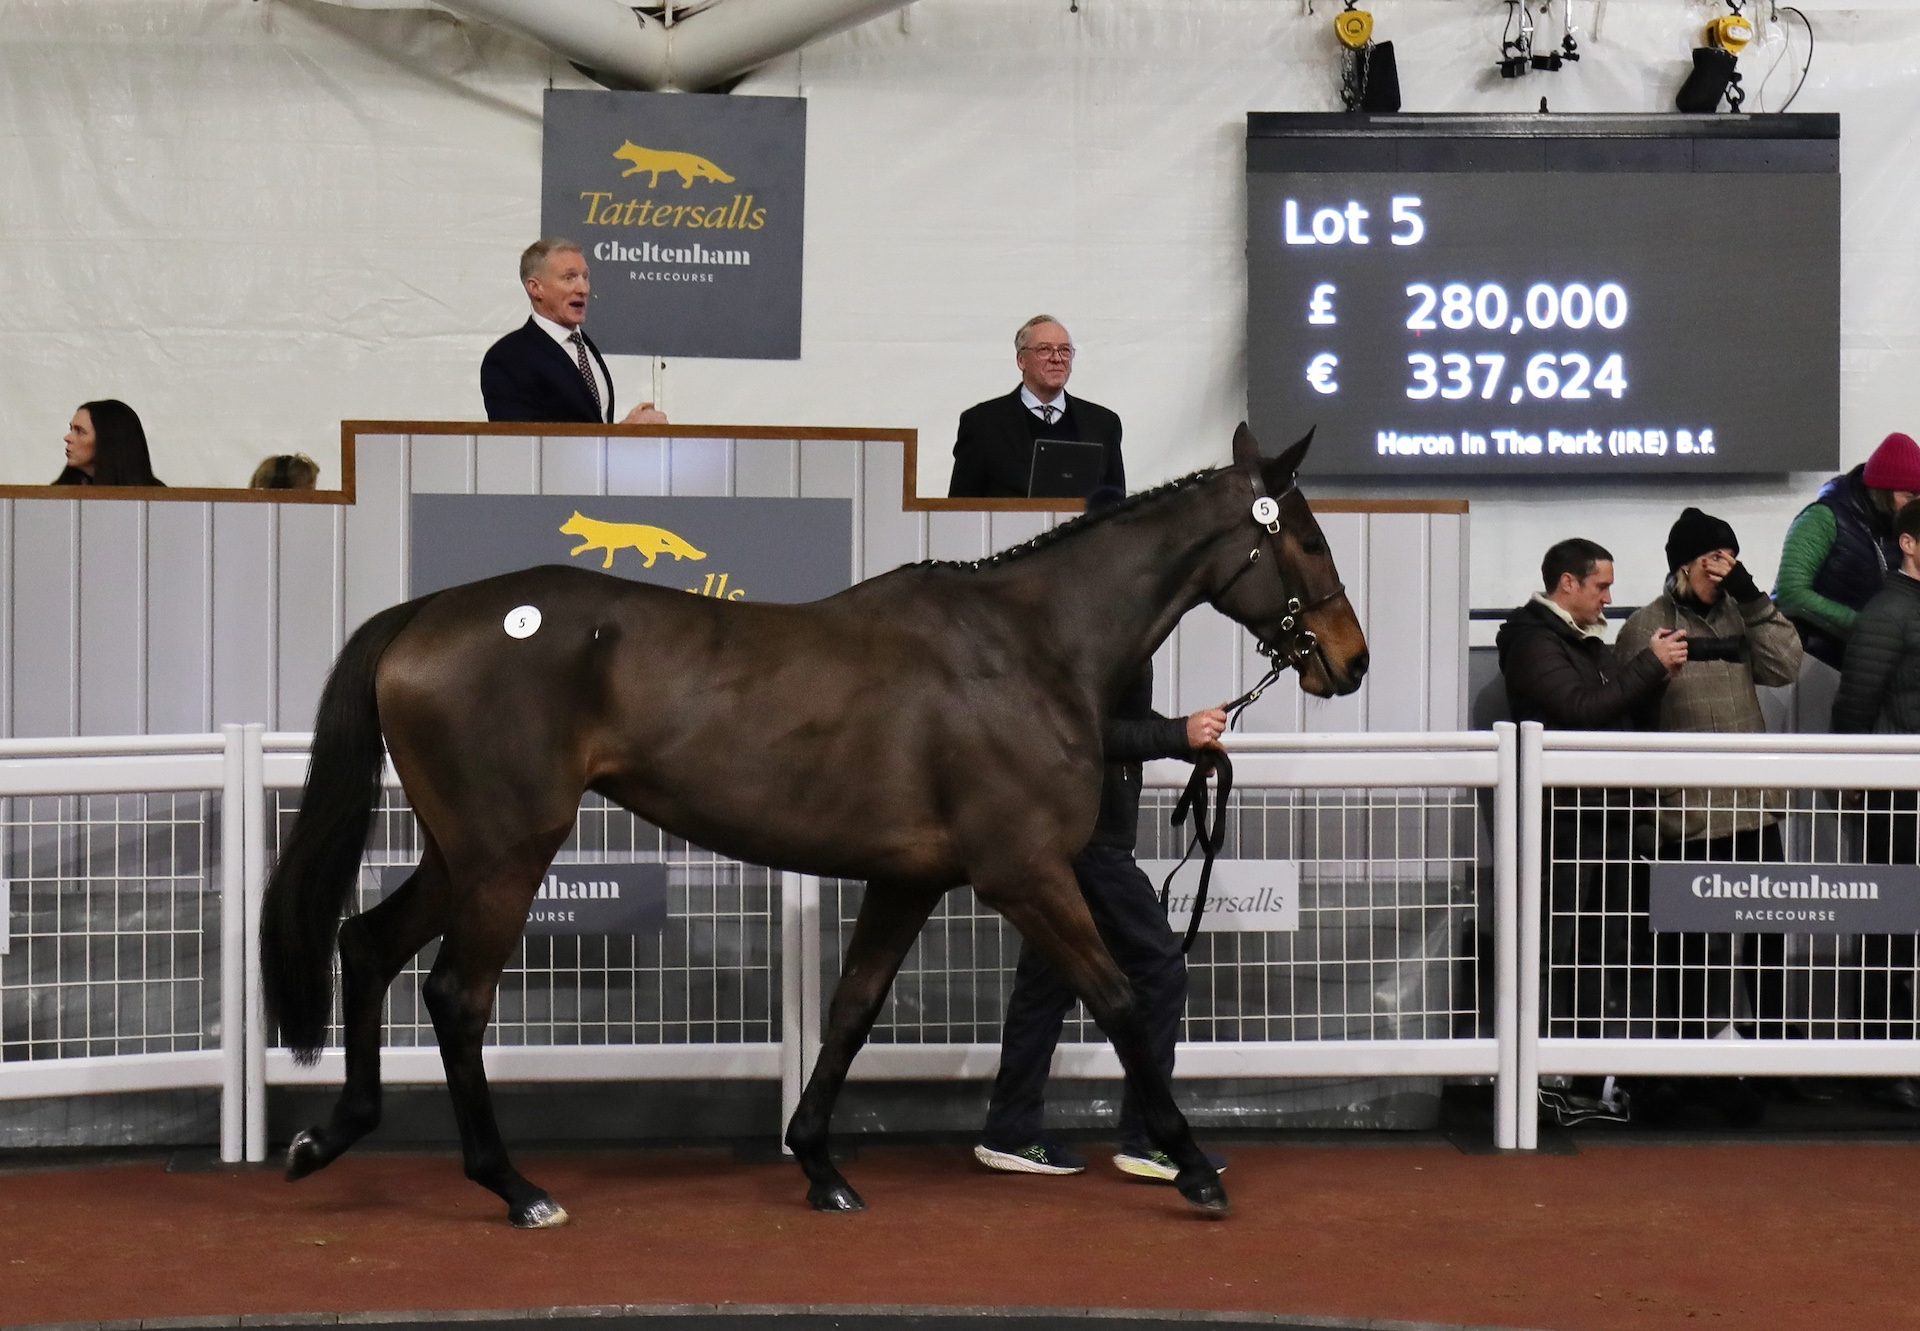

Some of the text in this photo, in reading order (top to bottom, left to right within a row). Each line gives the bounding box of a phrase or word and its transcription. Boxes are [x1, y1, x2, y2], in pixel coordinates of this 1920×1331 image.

[580, 191, 768, 230] Tattersalls
[1284, 196, 1426, 246] Lot 5
[593, 240, 751, 266] Cheltenham
[629, 271, 714, 283] RACECOURSE
[1308, 282, 1629, 335] £ 280,000
[1306, 352, 1628, 405] € 337,624
[1377, 431, 1456, 456] Heron
[1461, 431, 1487, 456] In
[1490, 429, 1544, 456] The
[1547, 430, 1604, 456] Park
[1608, 430, 1669, 457] (IRE)
[1260, 502, 1270, 516] 5
[1692, 873, 1879, 900] Cheltenham
[1735, 910, 1835, 921] RACECOURSE
